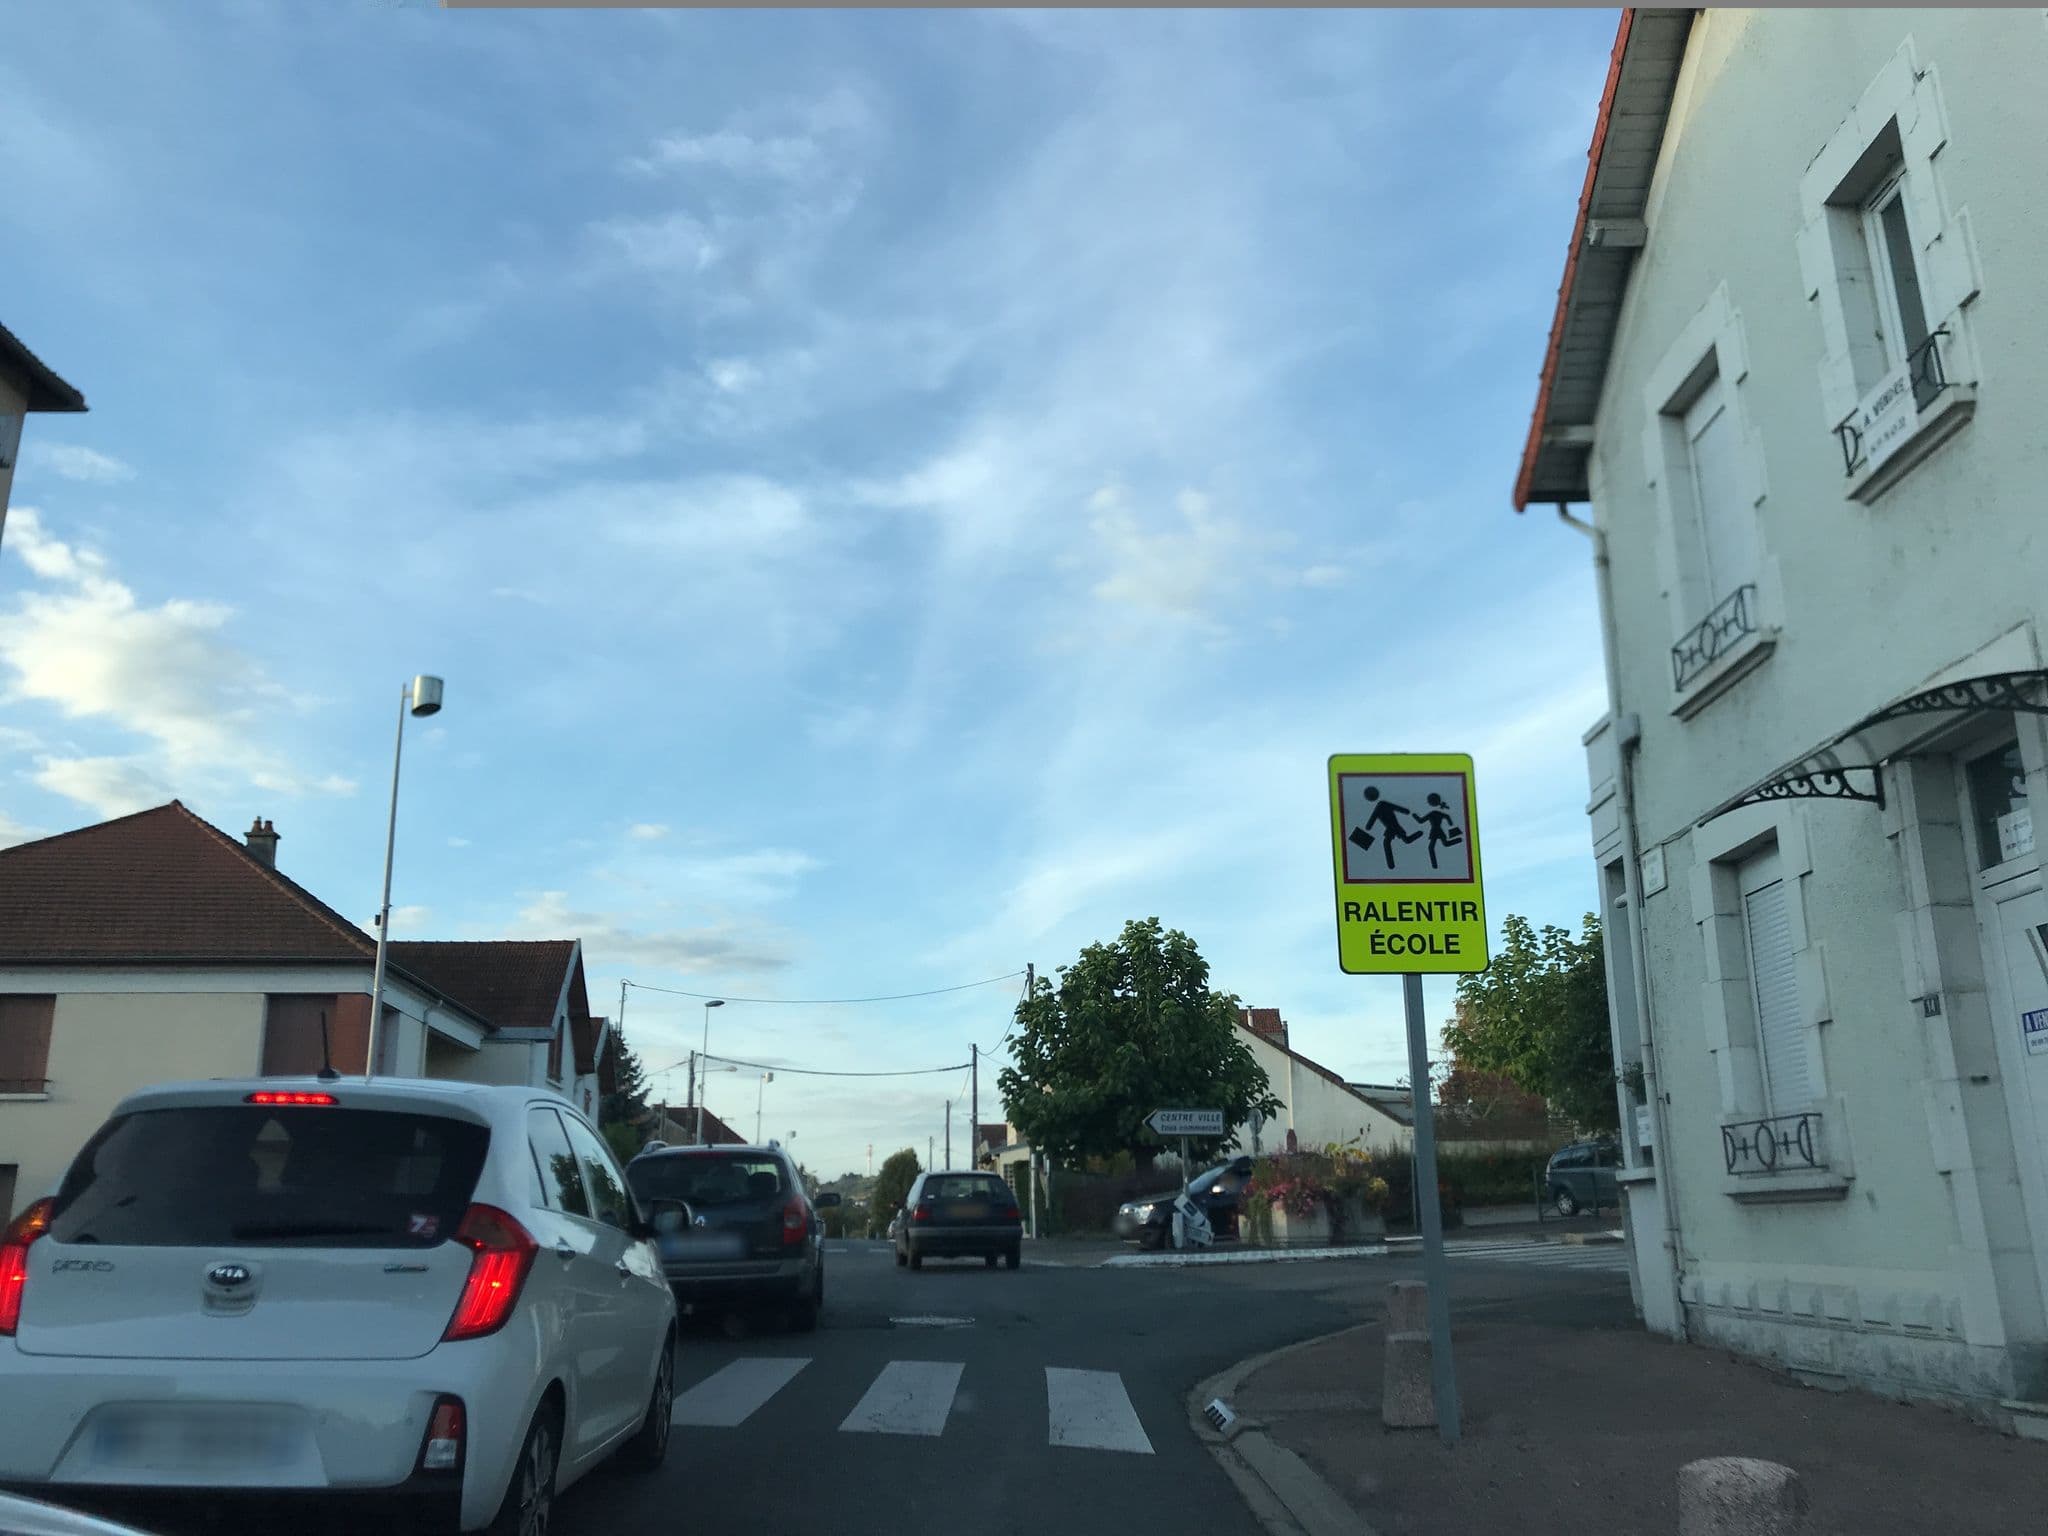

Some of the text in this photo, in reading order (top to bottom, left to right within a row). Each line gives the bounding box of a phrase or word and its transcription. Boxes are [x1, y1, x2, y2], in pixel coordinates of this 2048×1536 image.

[1343, 901, 1479, 922] RALENTIR
[1370, 928, 1461, 955] ÉCOLE
[1160, 1112, 1221, 1122] CENTRE VILLE
[214, 1267, 245, 1279] KIA
